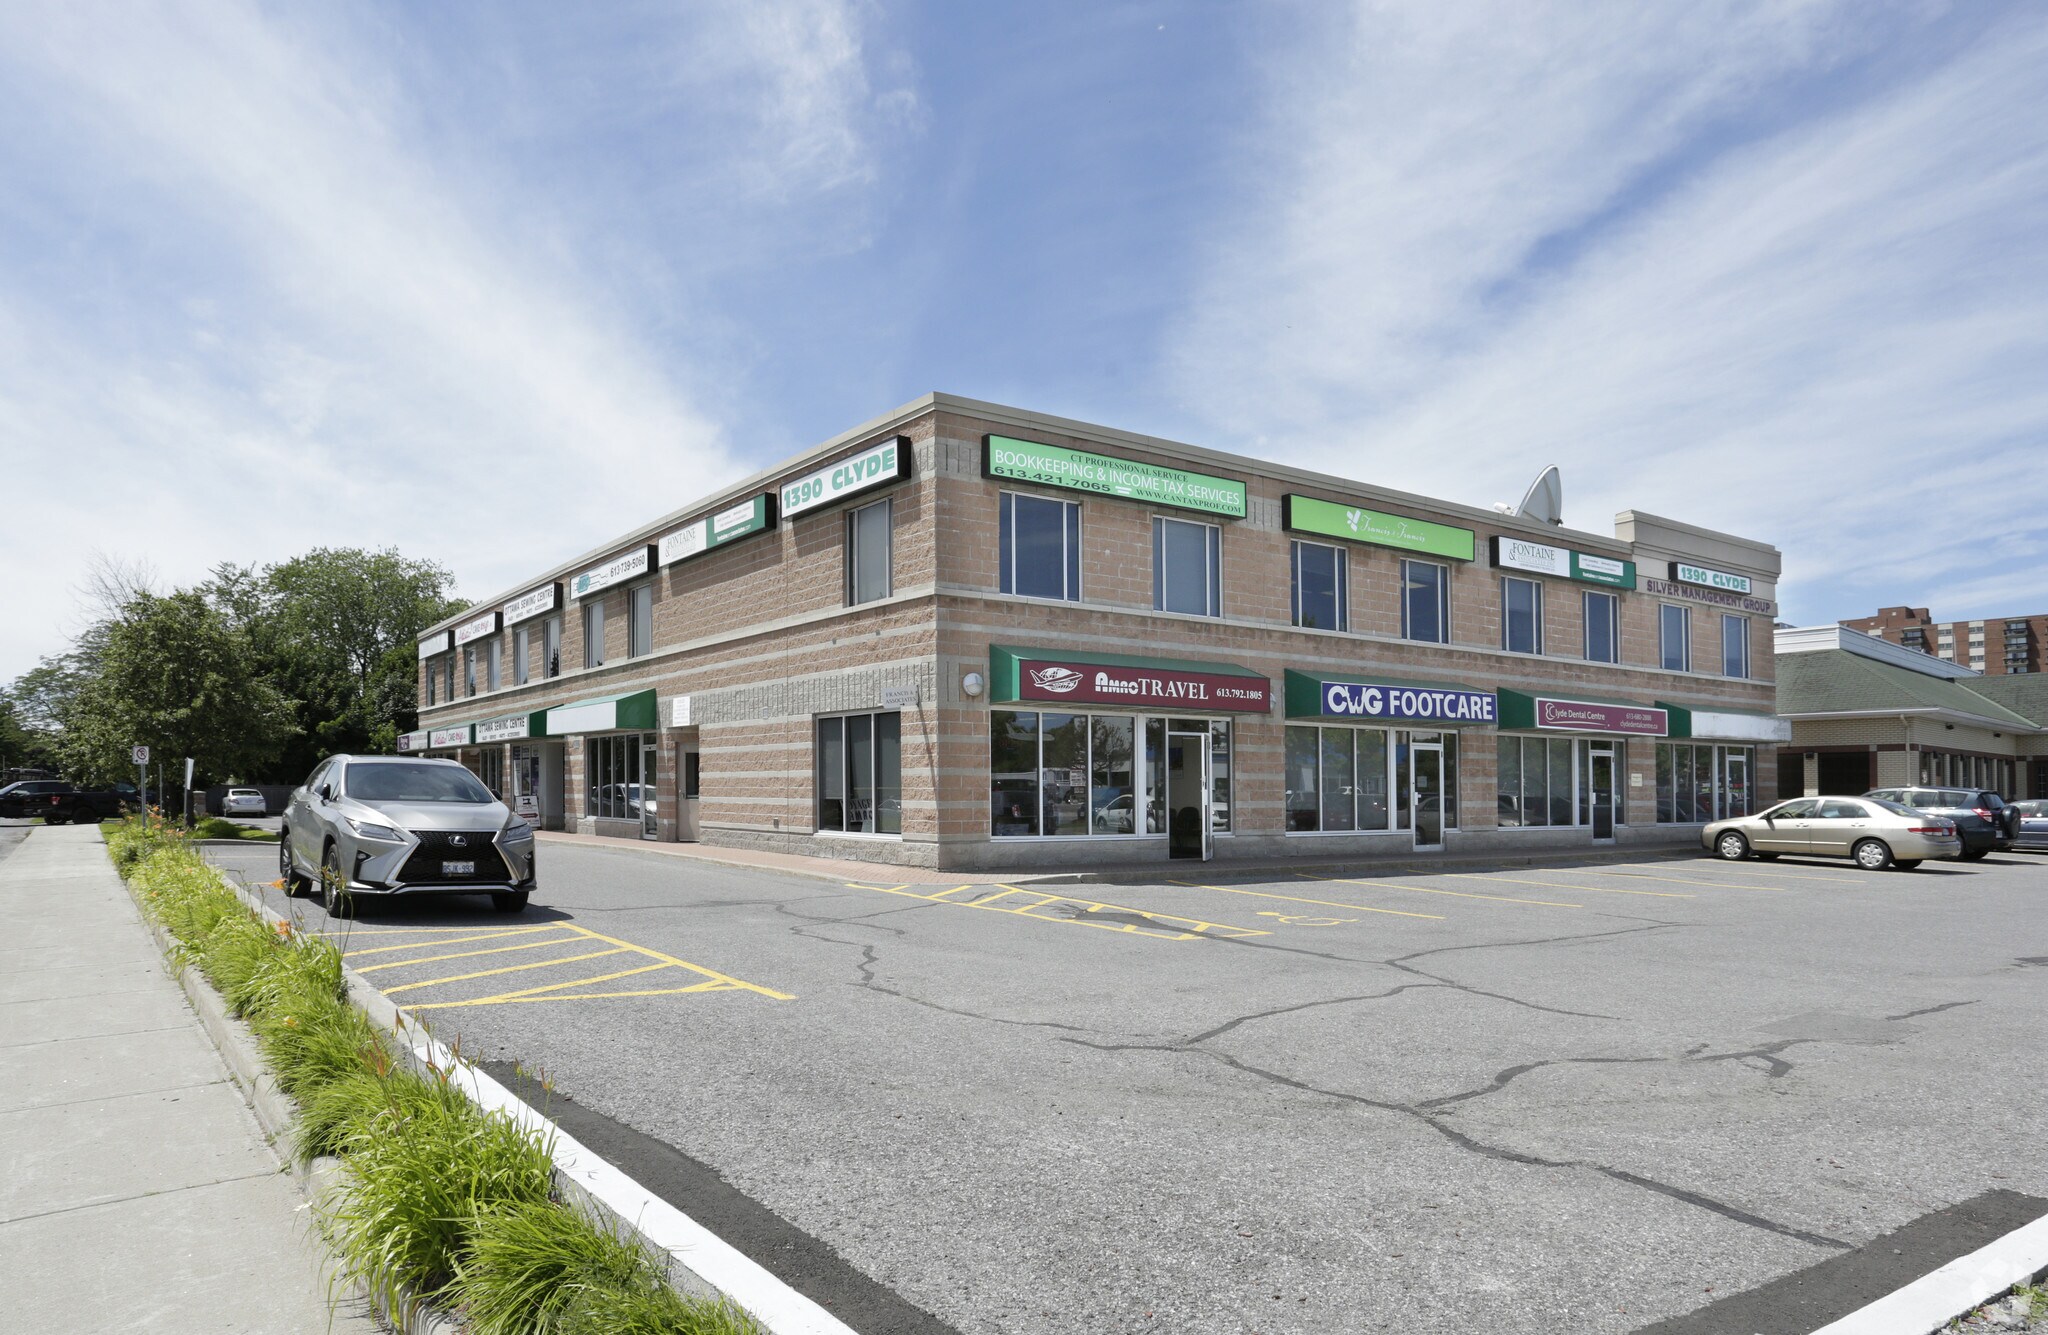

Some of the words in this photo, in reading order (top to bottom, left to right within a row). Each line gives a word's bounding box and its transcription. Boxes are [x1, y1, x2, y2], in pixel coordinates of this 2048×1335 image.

[783, 478, 822, 509] 1390
[831, 447, 895, 491] CLYDE
[994, 466, 1111, 492] 613.421.7065
[995, 449, 1094, 479] BOOKKEEPING
[1096, 467, 1106, 481] &
[1109, 469, 1160, 491] INCOME
[1161, 479, 1185, 496] TAX
[1187, 484, 1240, 505] SERVICES
[1070, 454, 1083, 463] CT
[1085, 456, 1151, 476] PROFESSIONAL
[1152, 469, 1188, 482] SERVICE
[1136, 489, 1241, 513] WWW.CANTAXPROF.COM
[667, 527, 696, 549] FONTAINE
[1508, 549, 1516, 561] &
[1512, 542, 1555, 561] FONTAINE
[1681, 566, 1707, 583] 1390
[1712, 573, 1747, 590] CLYDE
[1647, 580, 1680, 597] SILVER
[1681, 587, 1742, 608] MANAGEMENT
[1743, 598, 1771, 613] GROUP
[1138, 678, 1209, 700] TRAVEL
[1216, 687, 1263, 700] 613.792.1805
[1389, 690, 1493, 720] FOOTCARE
[1568, 709, 1587, 719] Dental
[1587, 711, 1606, 721] Centre
